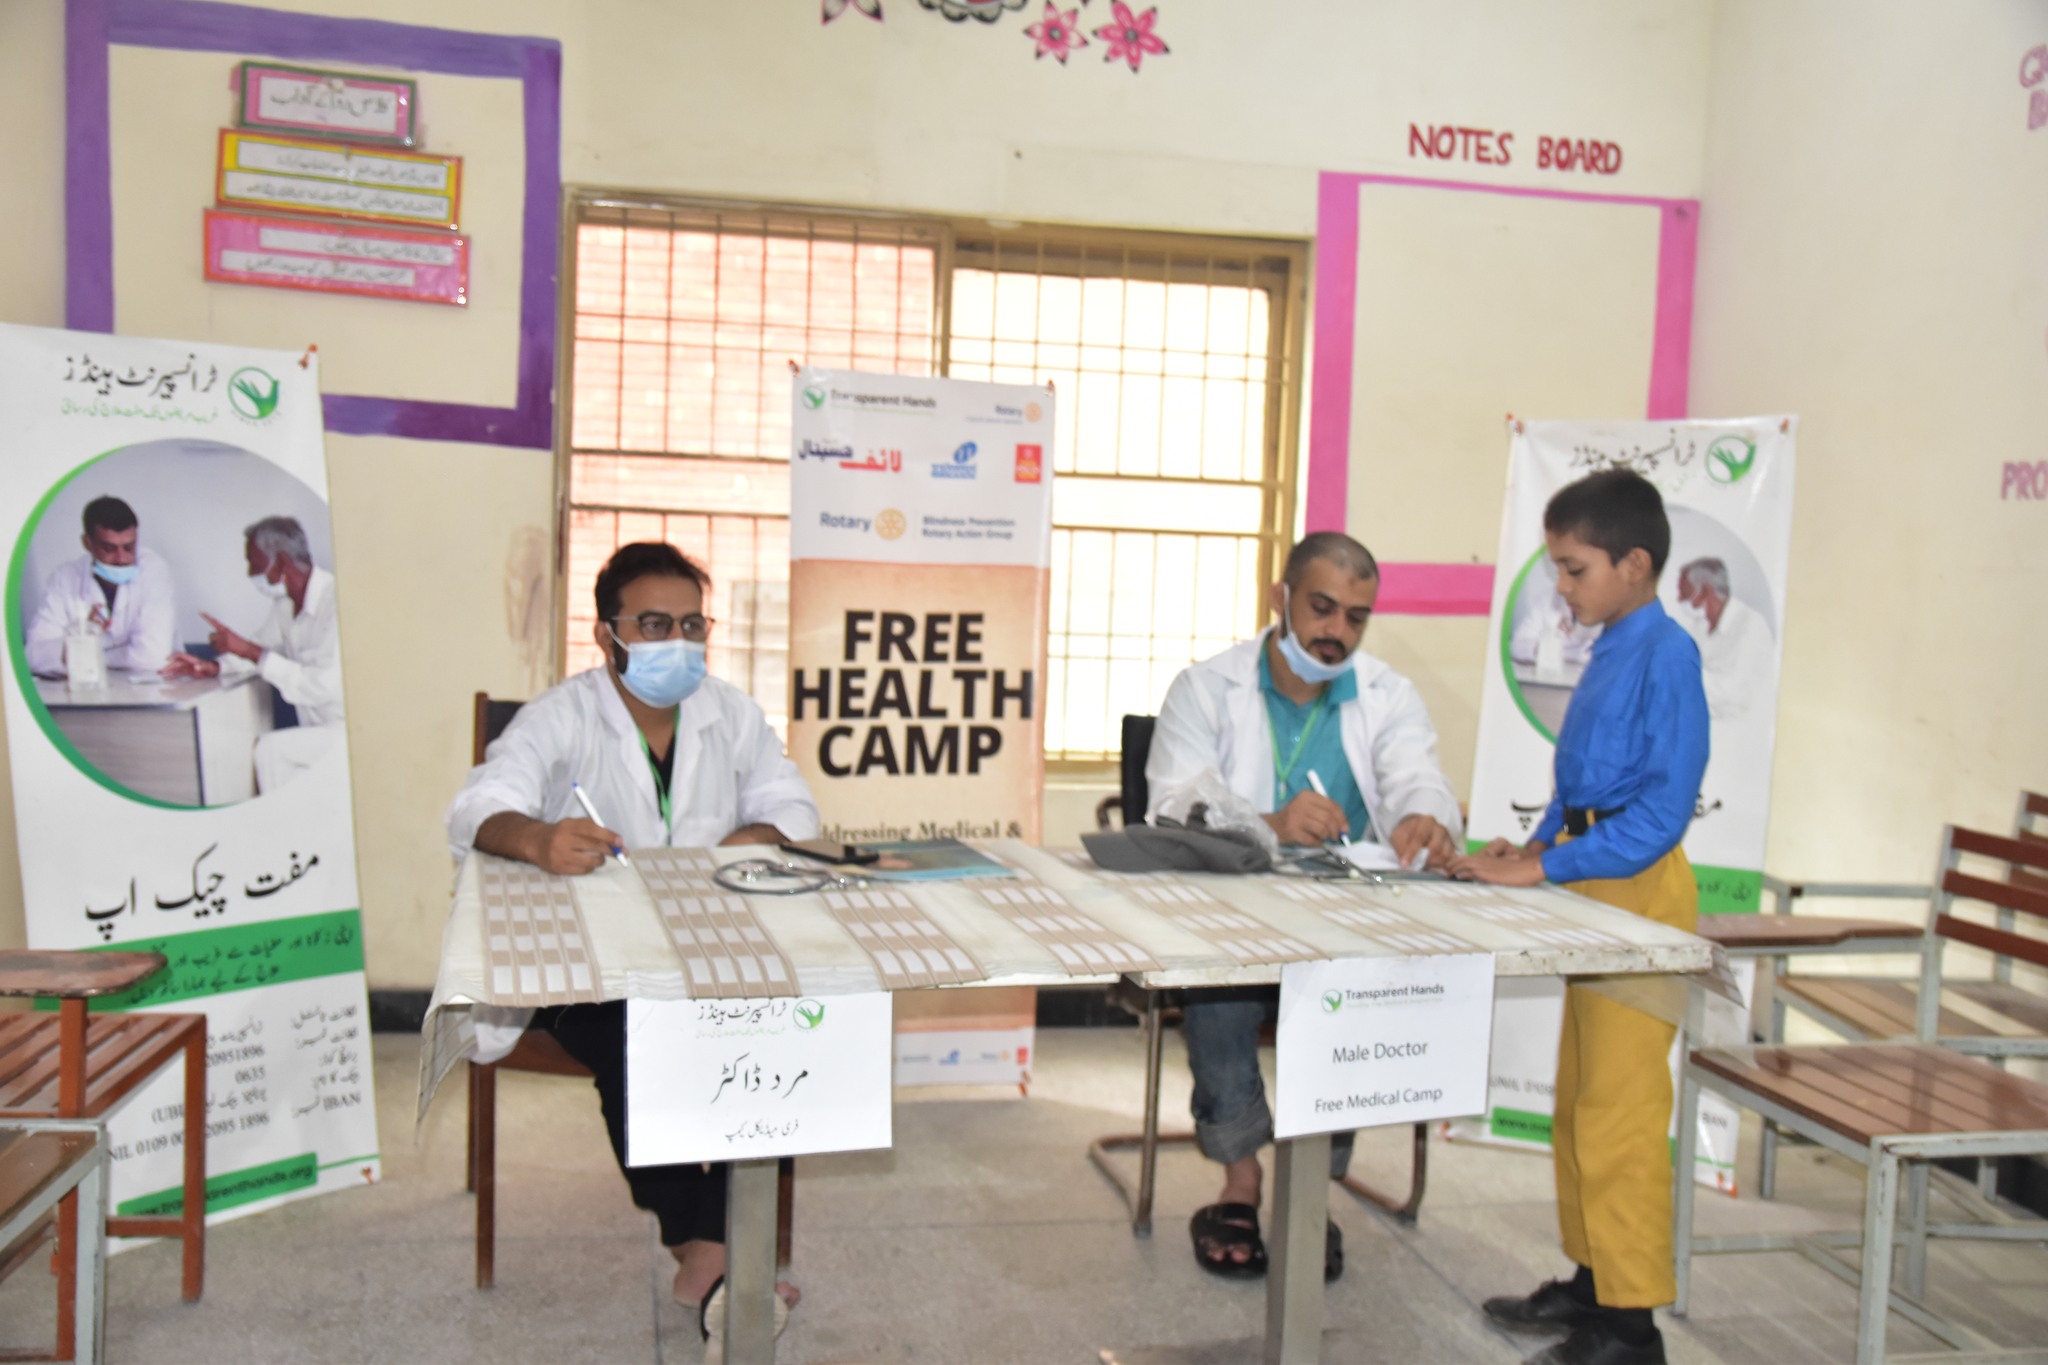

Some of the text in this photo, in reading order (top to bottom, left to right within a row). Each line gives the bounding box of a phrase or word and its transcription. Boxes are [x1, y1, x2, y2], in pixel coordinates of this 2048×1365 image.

[1409, 122, 1622, 175] NOTES BOARD
[902, 395, 936, 409] Hands
[820, 512, 871, 532] Rotary
[844, 610, 985, 664] FREE
[792, 668, 1034, 722] HEALTH
[818, 724, 1003, 778] CAMP
[821, 820, 1023, 843] ddressing Medical &
[86, 843, 319, 940] مفت چیک اپ
[1345, 984, 1444, 1001] Transparent Hands
[1333, 1041, 1428, 1063] Male Doctor
[710, 1052, 809, 1104] مرد ڈاکٹر
[1315, 1087, 1442, 1113] Free Medical Camp
